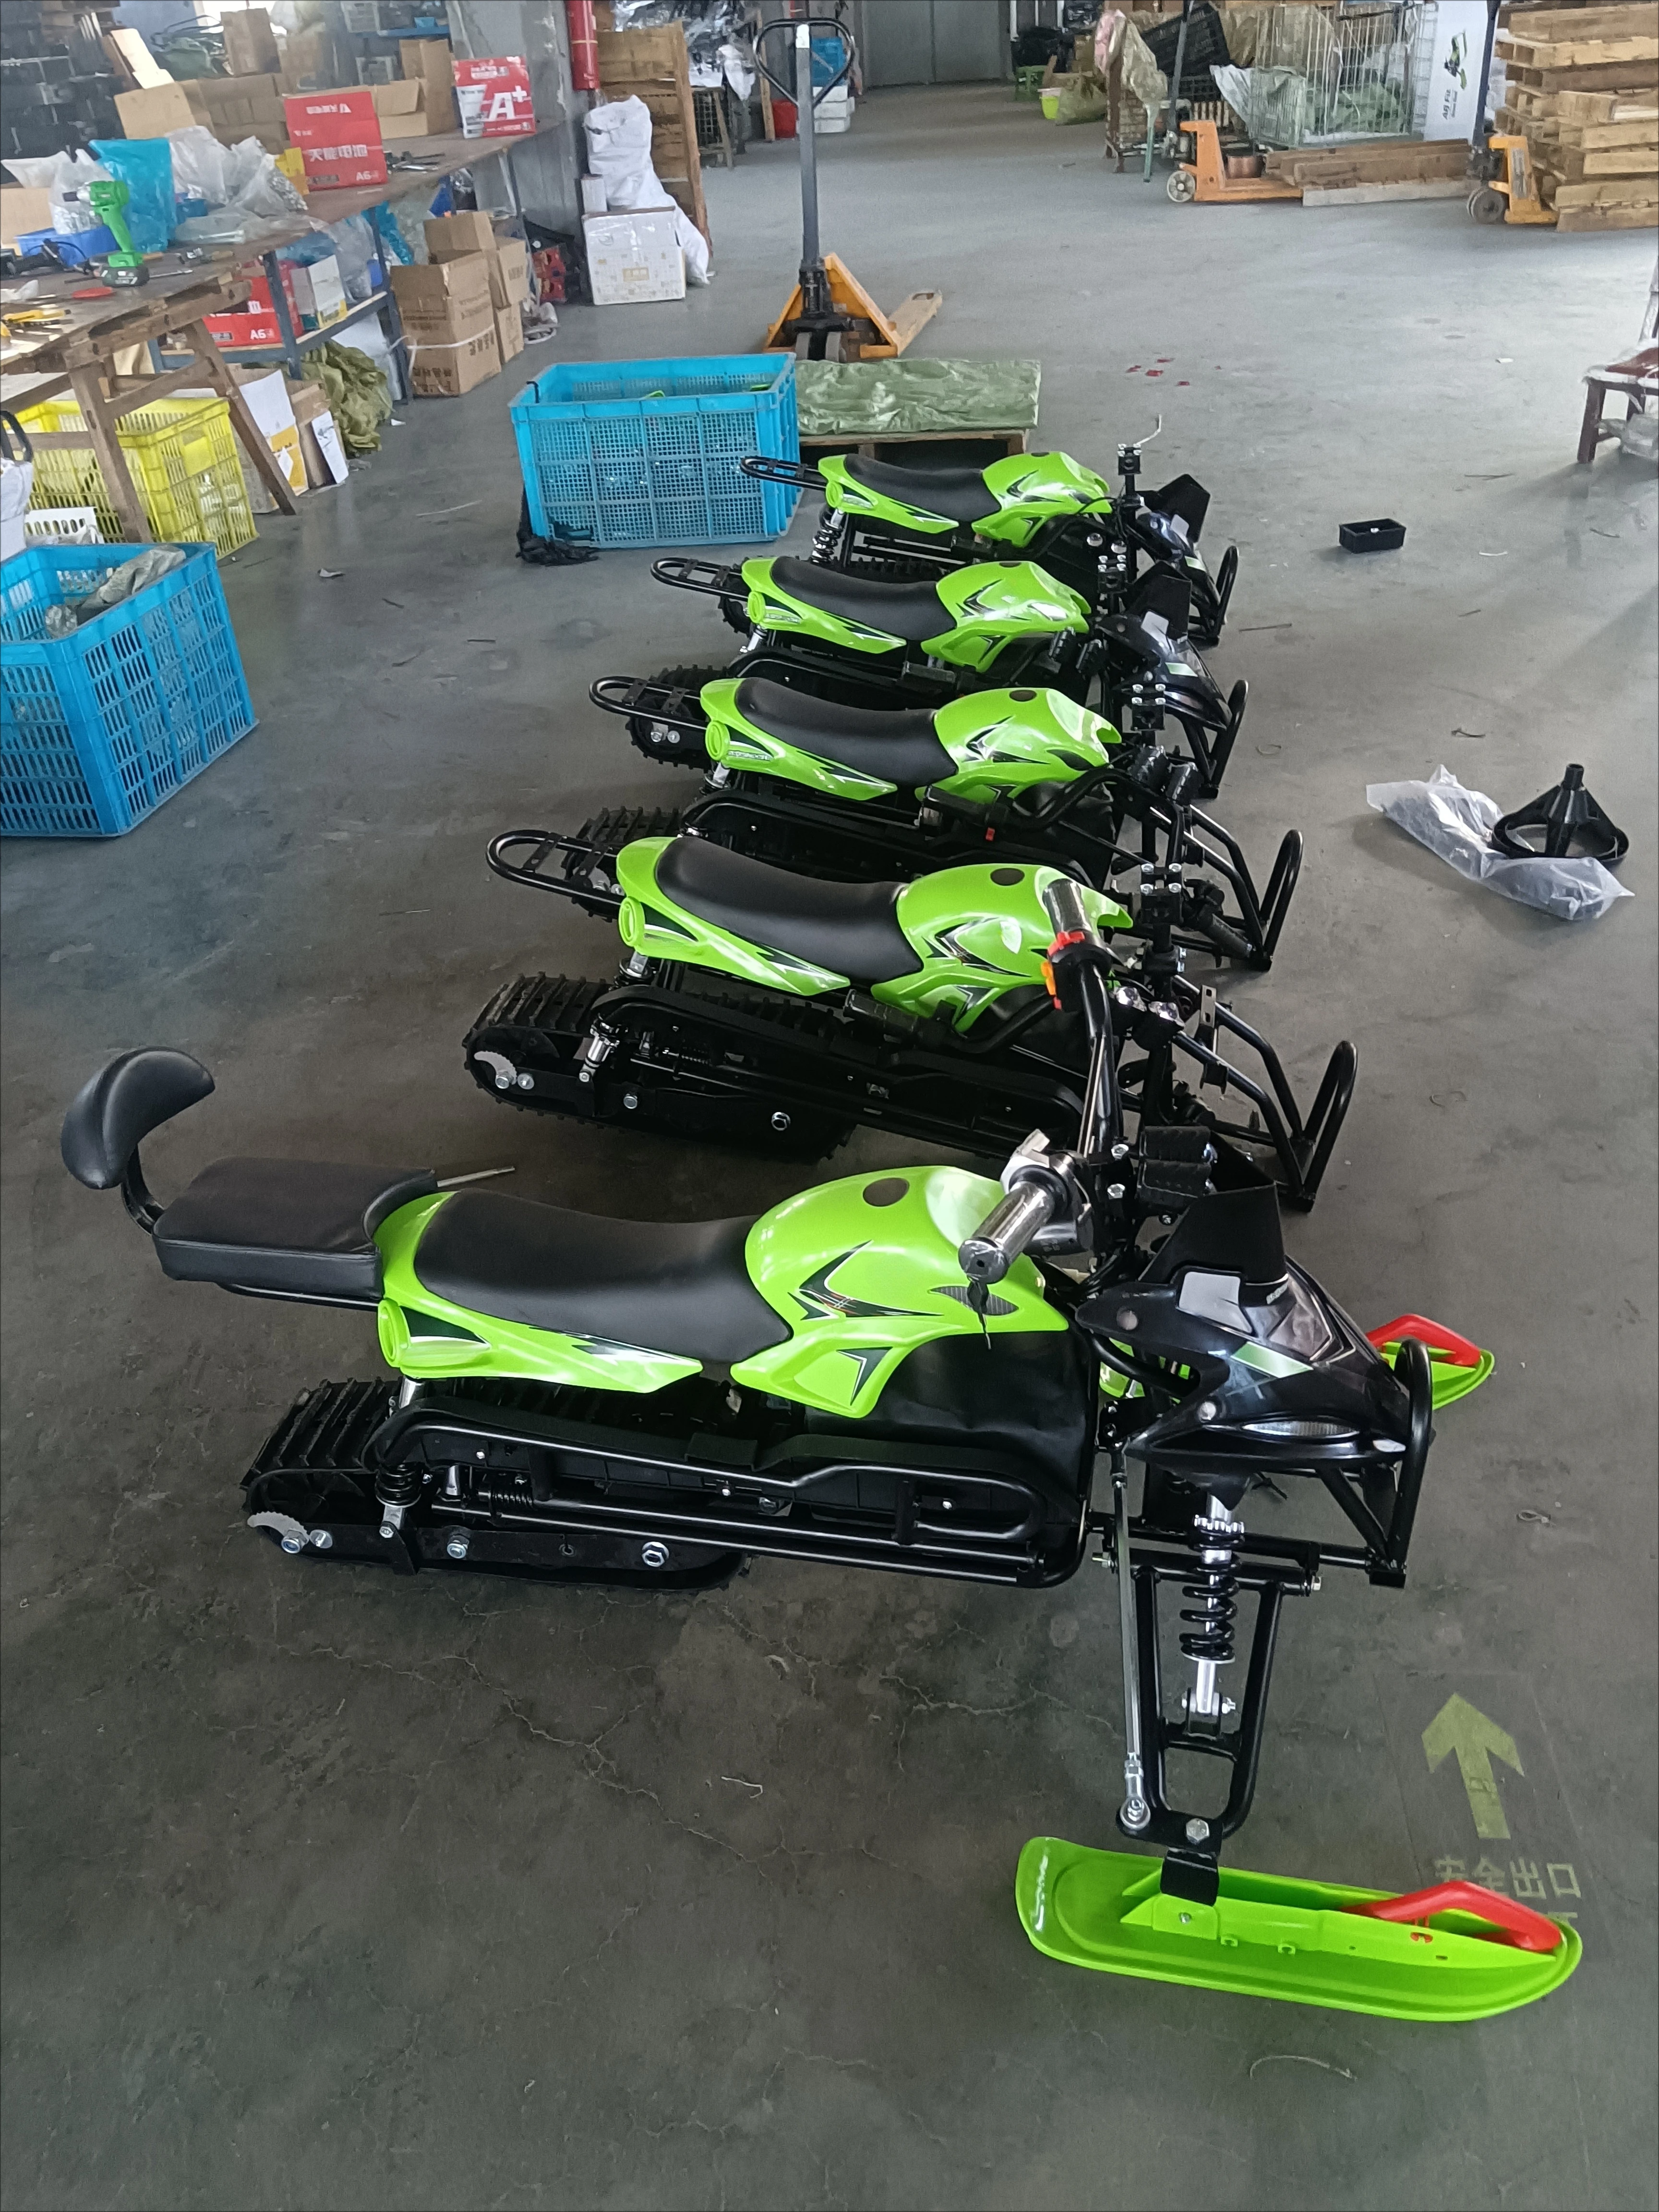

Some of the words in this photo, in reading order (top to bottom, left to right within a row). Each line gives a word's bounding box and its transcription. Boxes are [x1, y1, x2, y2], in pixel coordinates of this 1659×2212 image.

[488, 85, 528, 120] A+
[1433, 1854, 1581, 1899] 安全出口
